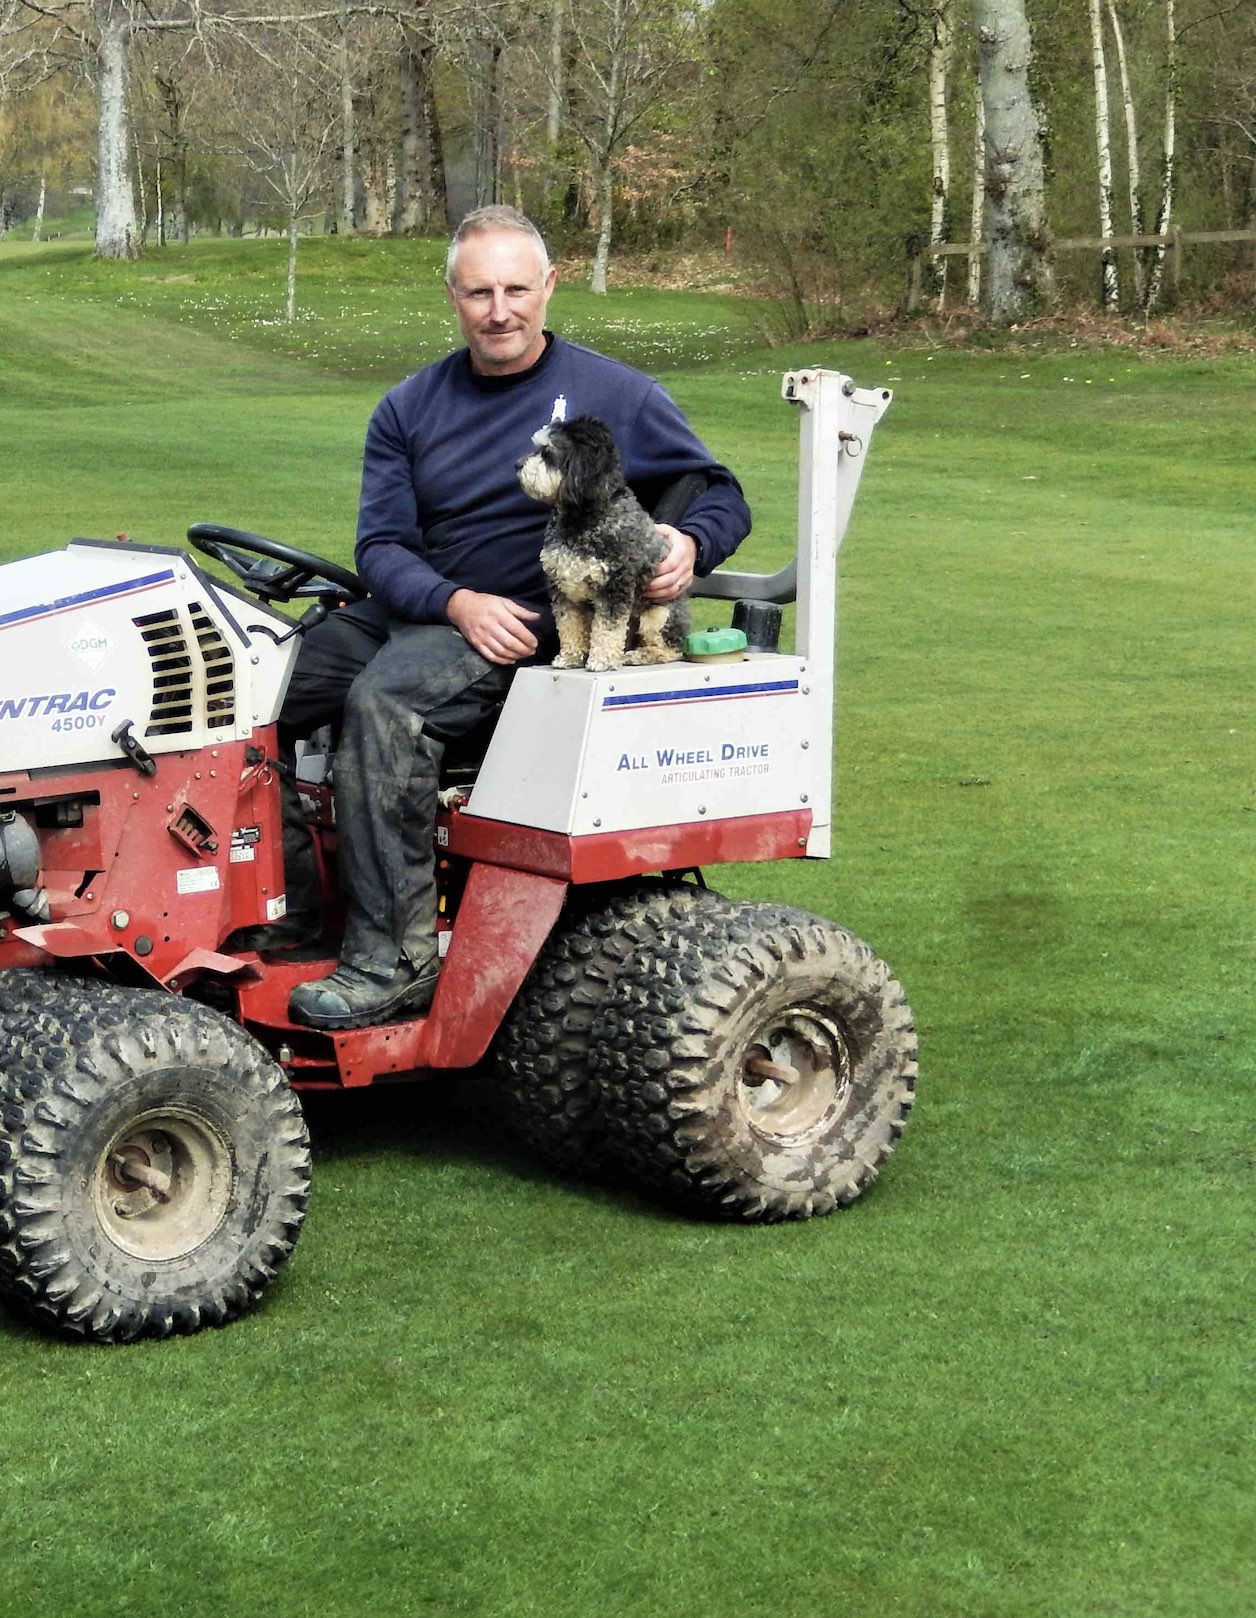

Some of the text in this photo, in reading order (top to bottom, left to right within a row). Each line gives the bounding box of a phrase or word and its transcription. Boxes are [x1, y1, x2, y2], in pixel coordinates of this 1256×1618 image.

[51, 715, 107, 733] 4500Y
[616, 743, 770, 771] ALL WHEEL DRIVE
[661, 763, 770, 785] ARTICULATING TRACTOR
